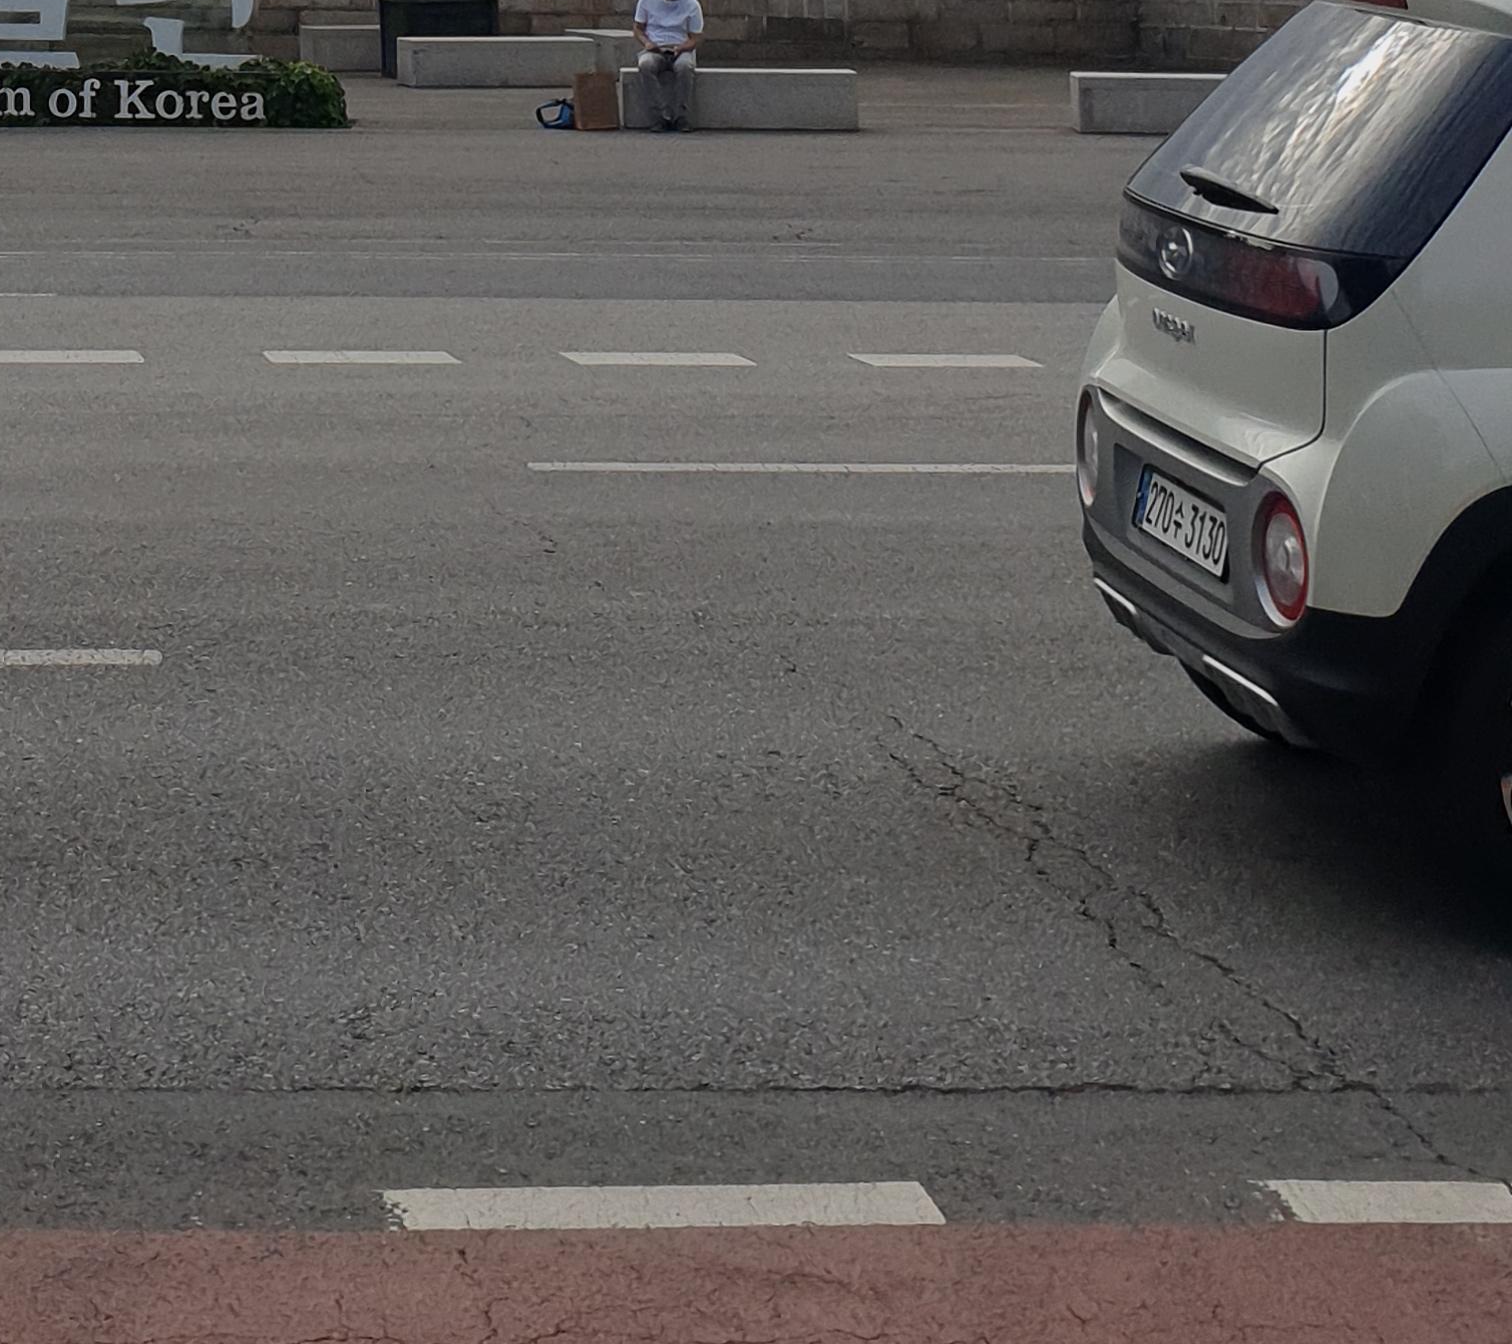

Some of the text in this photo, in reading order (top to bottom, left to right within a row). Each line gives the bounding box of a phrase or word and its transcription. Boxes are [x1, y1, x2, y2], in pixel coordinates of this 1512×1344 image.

[48, 78, 102, 119] of
[114, 79, 266, 120] Korea
[1185, 504, 1226, 565] 3130
